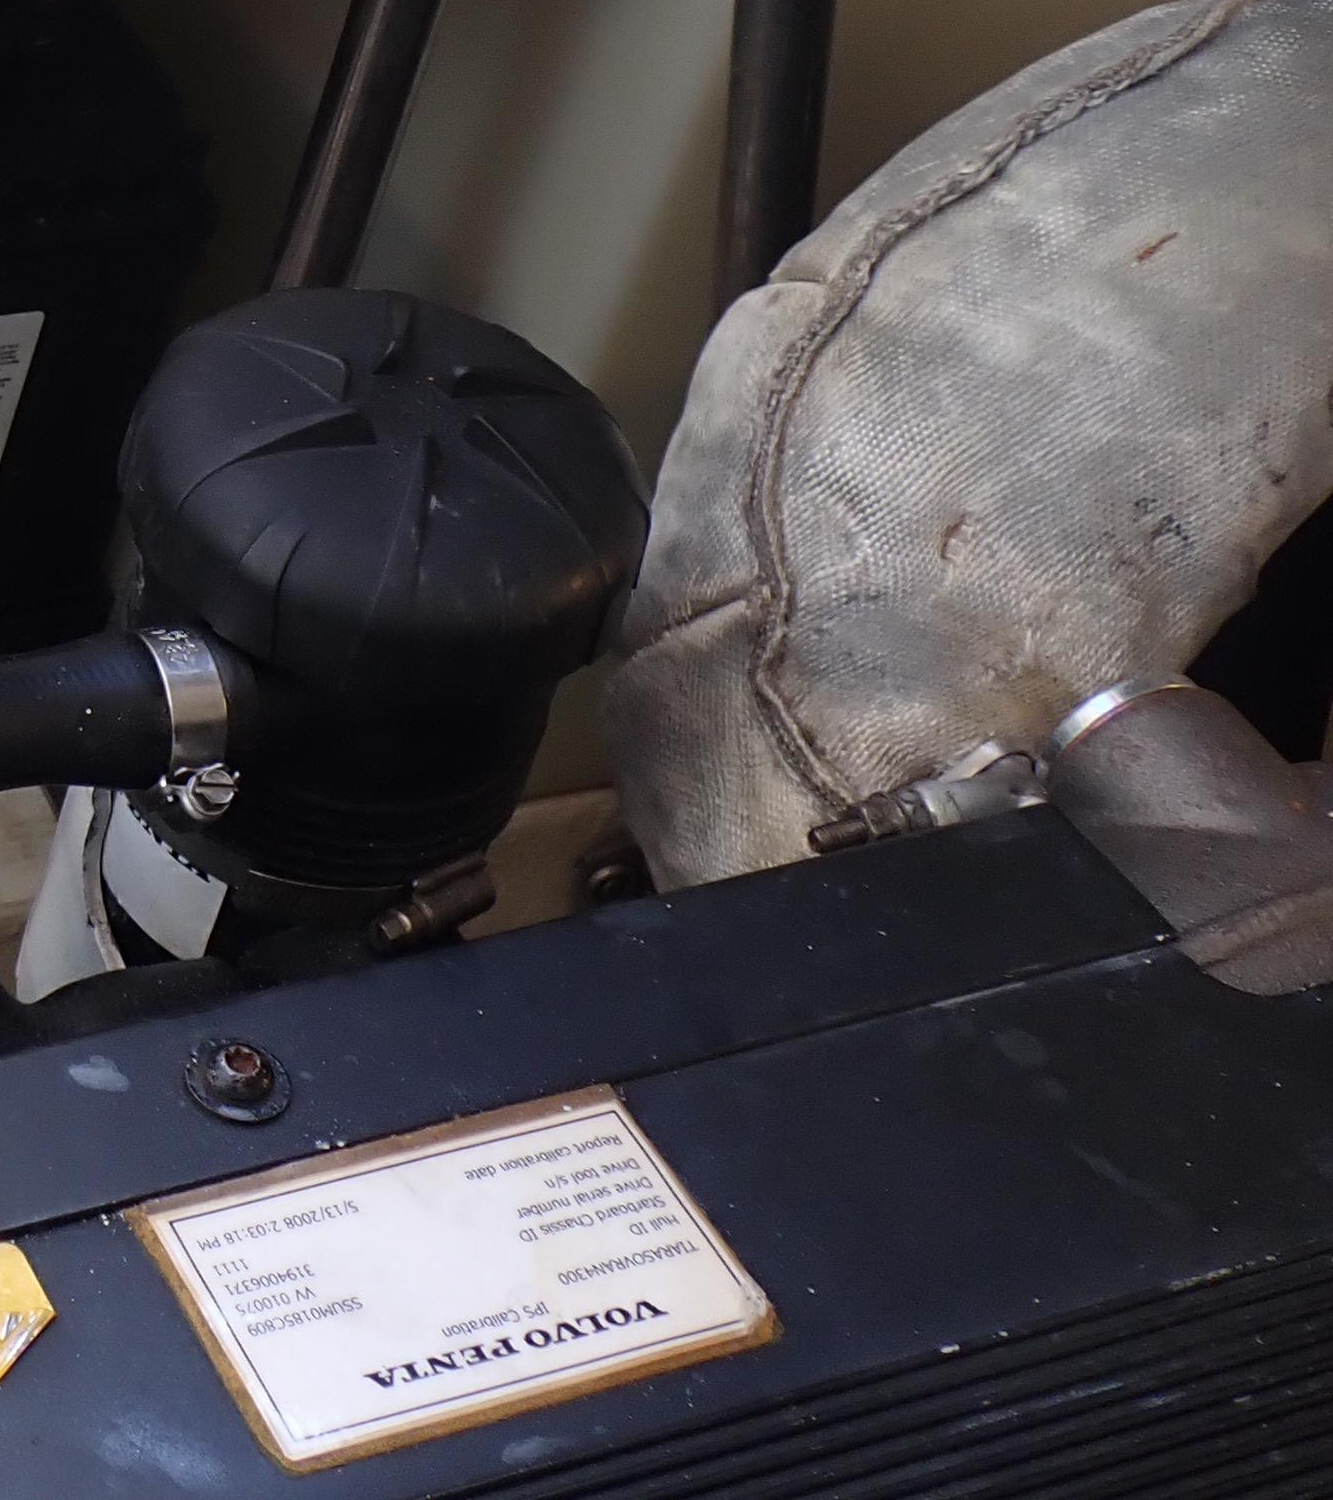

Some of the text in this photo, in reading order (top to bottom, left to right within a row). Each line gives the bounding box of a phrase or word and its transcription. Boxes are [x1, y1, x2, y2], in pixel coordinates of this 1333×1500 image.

[463, 1132, 624, 1183] Report calibration date
[543, 1156, 642, 1191] Drive tool s/n
[515, 1175, 654, 1221] Drive serial number
[517, 1194, 667, 1243] Starboard Chassis ID
[195, 1199, 360, 1252] 5/13/2008 2:03:18 PM
[627, 1213, 681, 1237] Hull ID
[211, 1257, 250, 1277] 1111
[223, 1262, 316, 1297] 3194006371
[557, 1239, 700, 1286] TIARASOVRAN4300
[440, 1300, 550, 1340] IPS Calibration
[362, 1299, 669, 1390] VOLVO PENTA
